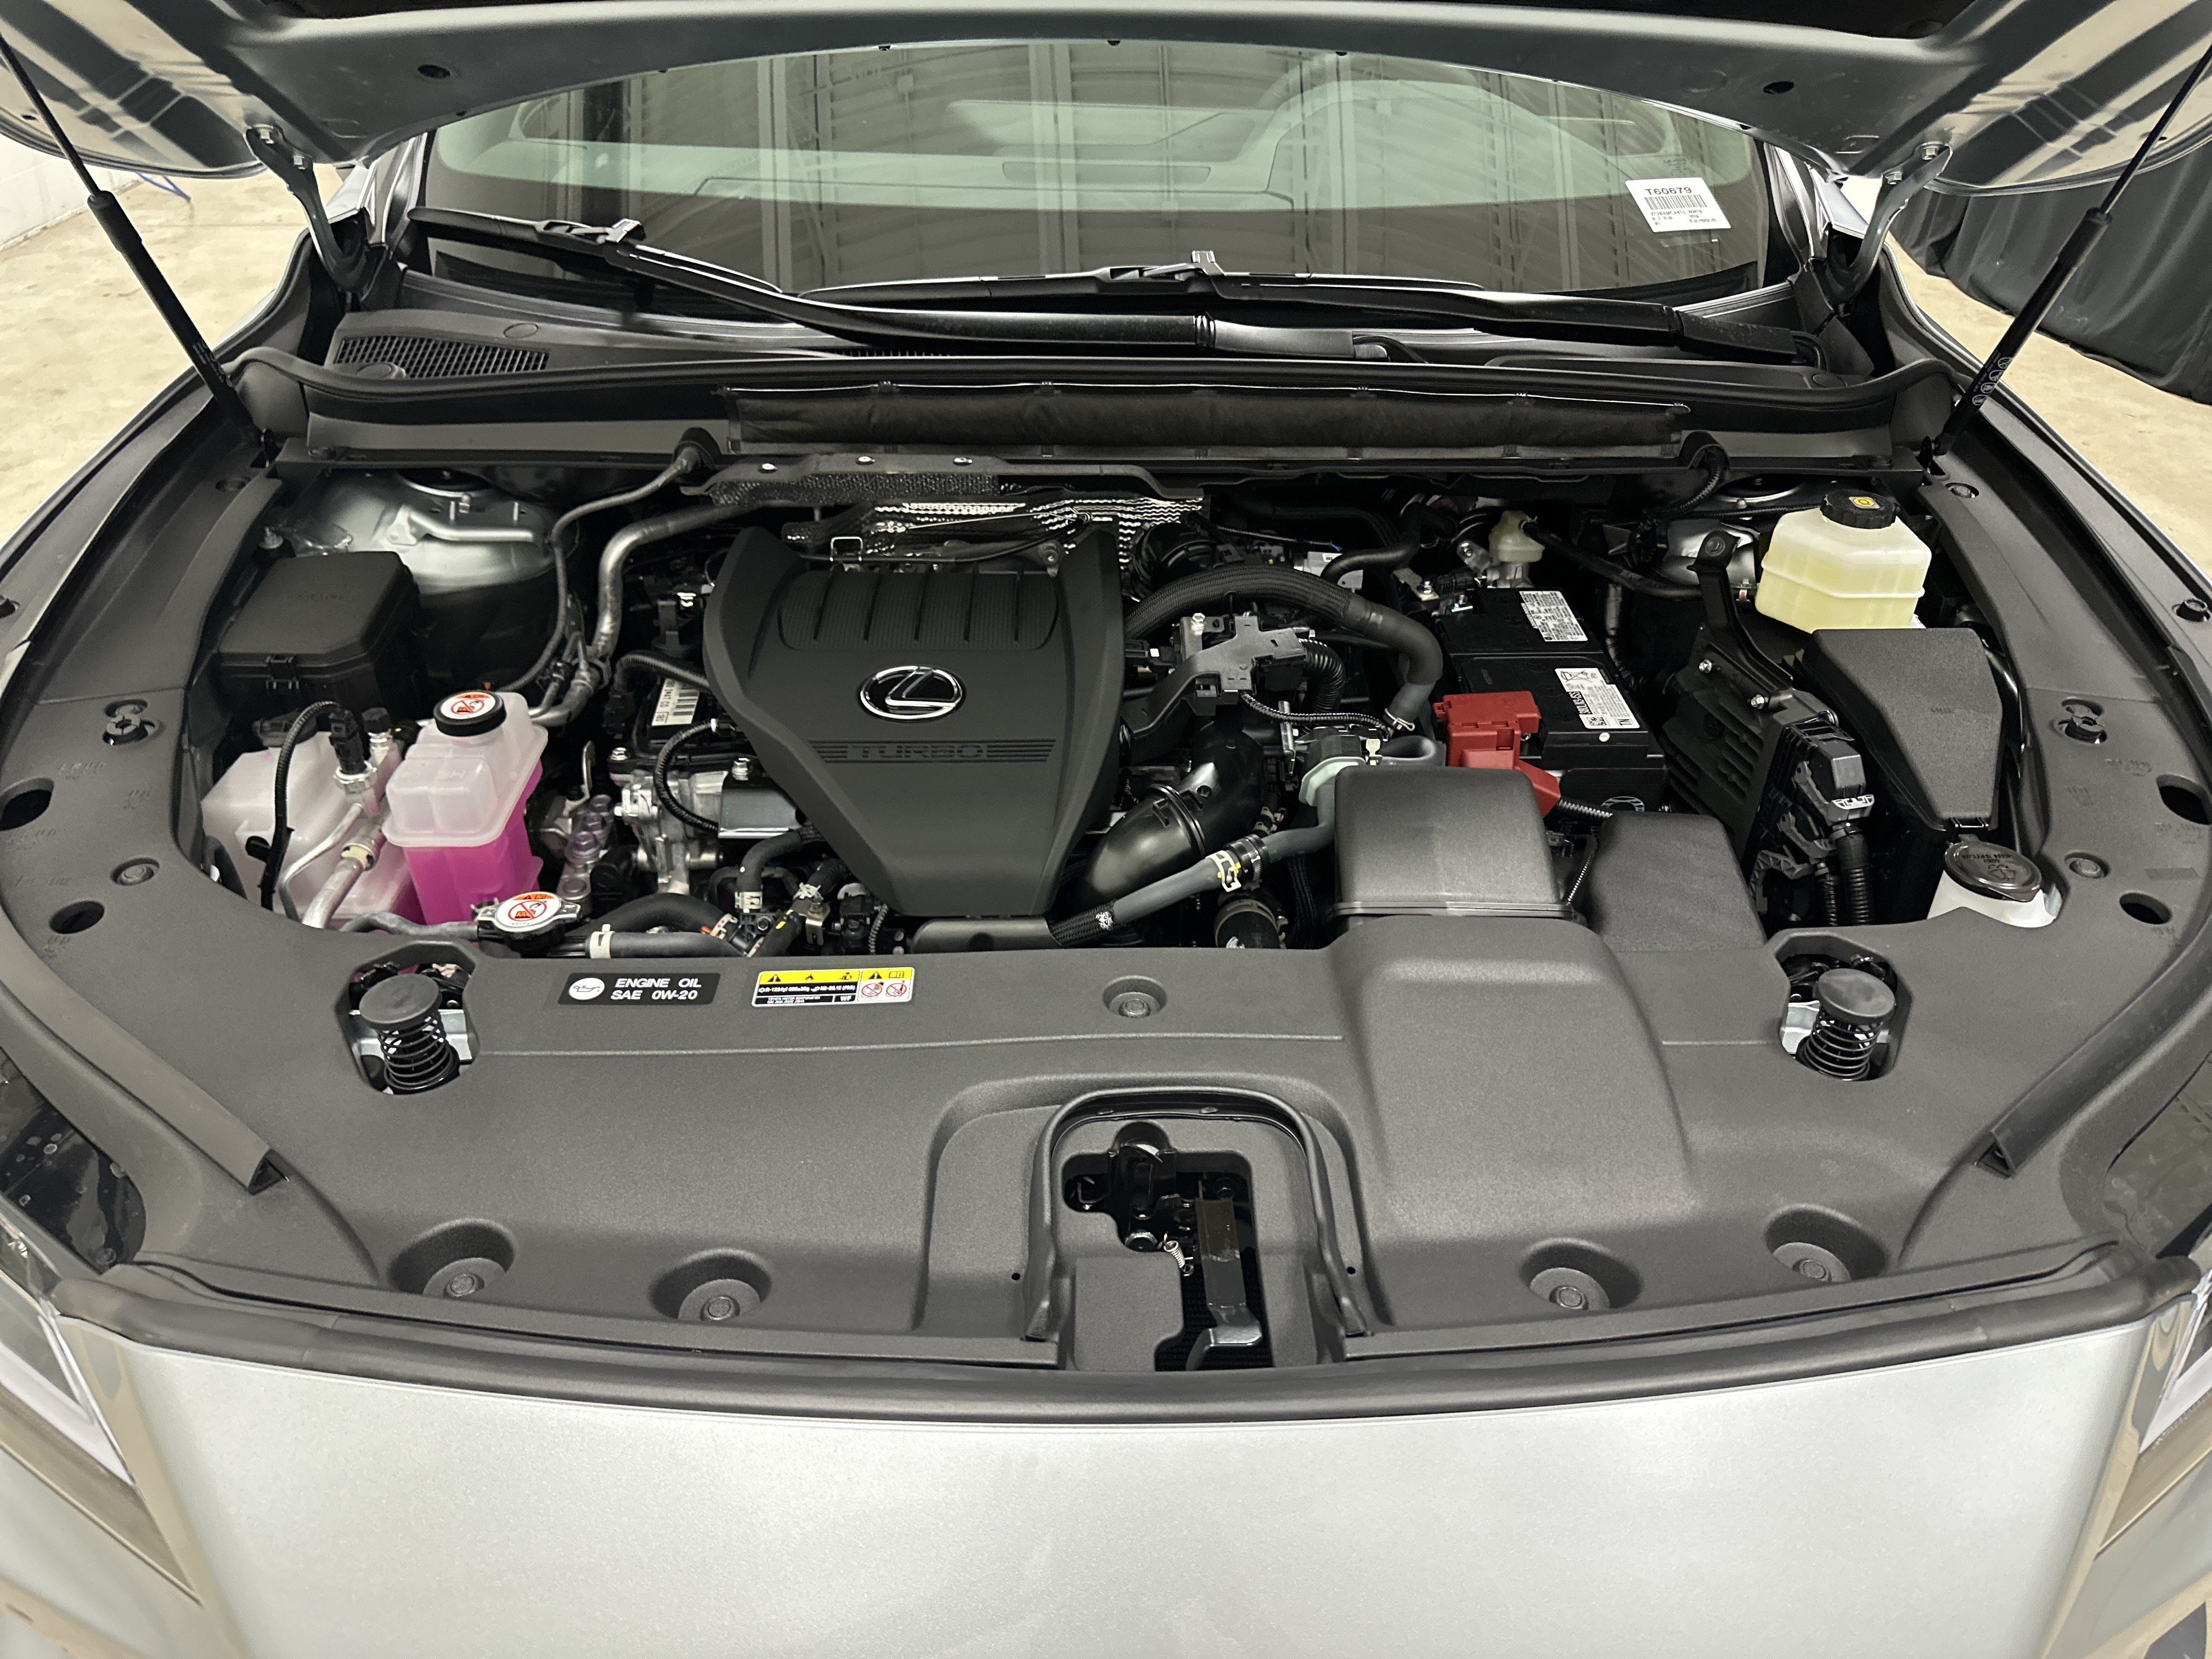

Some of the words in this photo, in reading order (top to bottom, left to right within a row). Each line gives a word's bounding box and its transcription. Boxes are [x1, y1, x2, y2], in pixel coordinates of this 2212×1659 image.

[852, 744, 984, 758] TURBO
[615, 978, 670, 988] ENGINE
[678, 978, 702, 988] OIL
[611, 990, 643, 1000] SAE
[652, 990, 698, 1000] 0W-20
